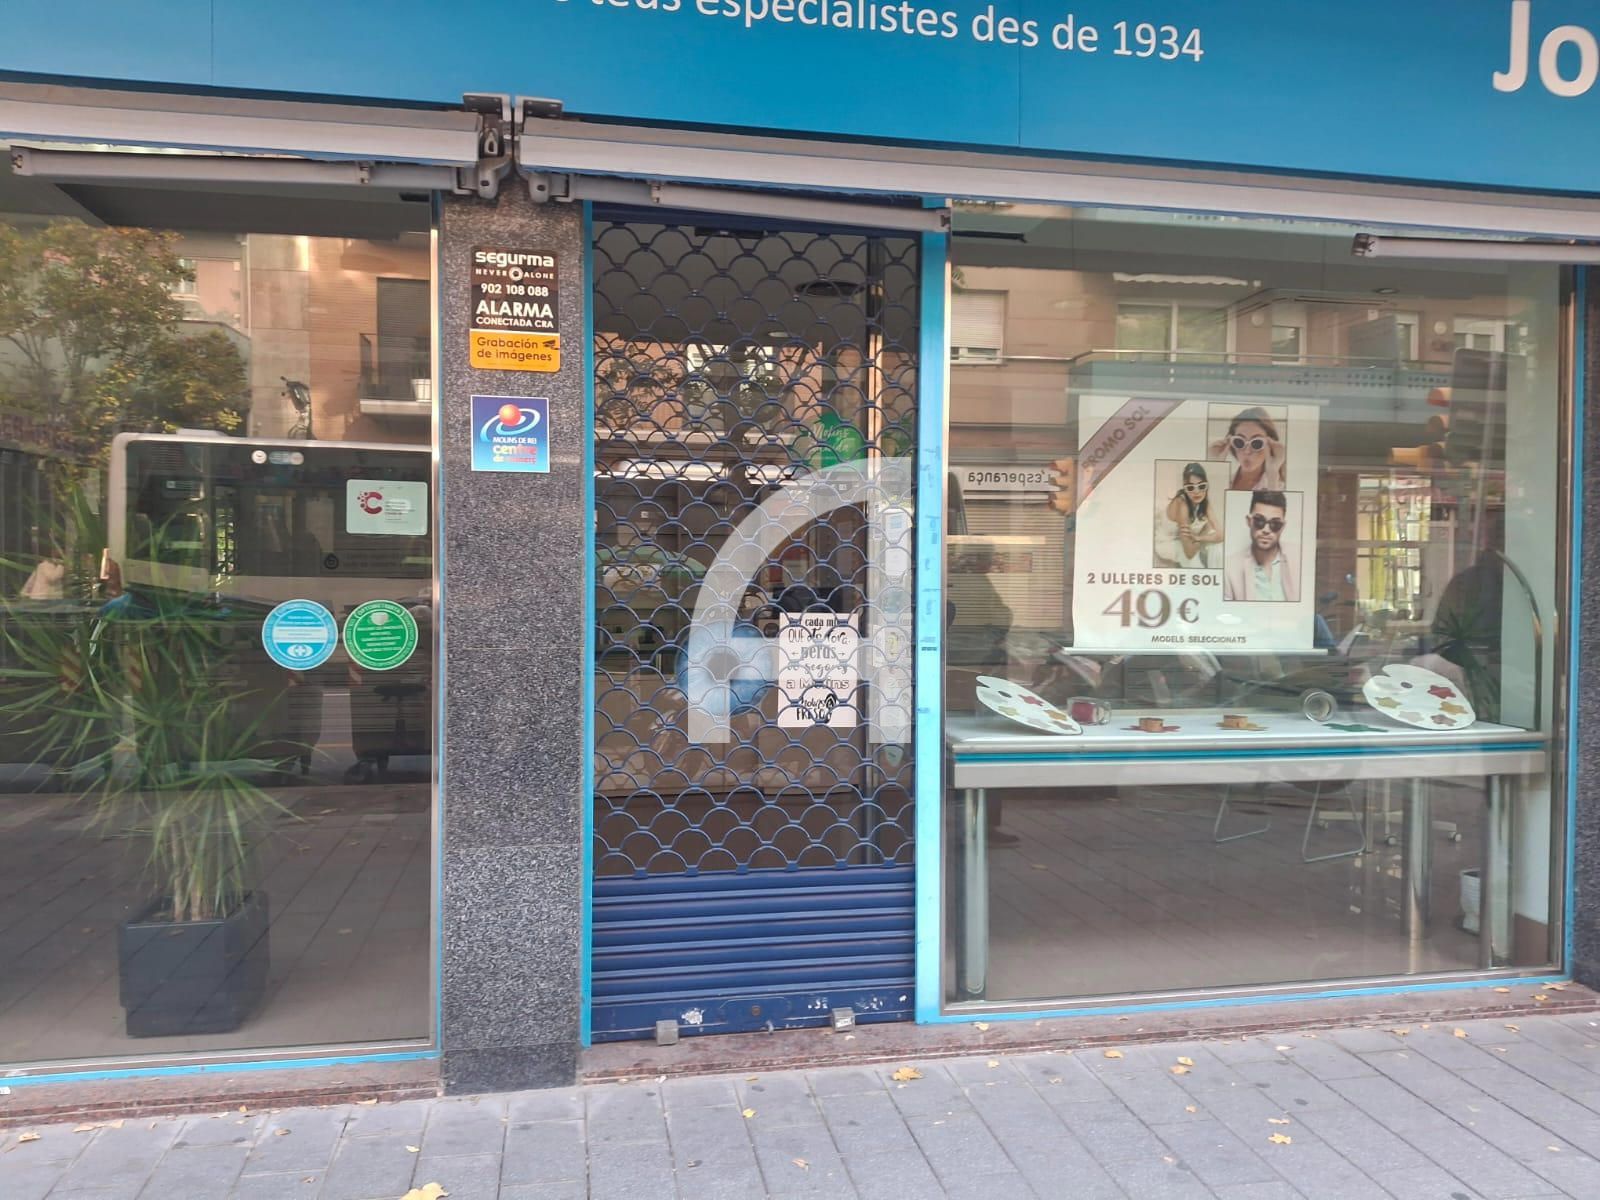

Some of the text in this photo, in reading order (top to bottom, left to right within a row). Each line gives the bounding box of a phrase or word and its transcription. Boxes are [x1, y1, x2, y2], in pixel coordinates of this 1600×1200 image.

[696, 0, 1204, 62] especialistes des de 1934
[1493, 0, 1599, 97] Jo
[475, 251, 554, 267] segurma
[475, 268, 554, 280] NEVER ALONE
[481, 283, 549, 297] 902 108 088
[476, 300, 554, 318] ALARMA
[476, 316, 554, 328] CONECTADA CRA
[477, 337, 538, 349] Grabación
[477, 349, 552, 361] de imágenes
[1124, 406, 1150, 430] SOL
[1087, 573, 1220, 586] 2 ULLERES DE SOL
[1151, 635, 1246, 644] MODELS SELECCIONATS
